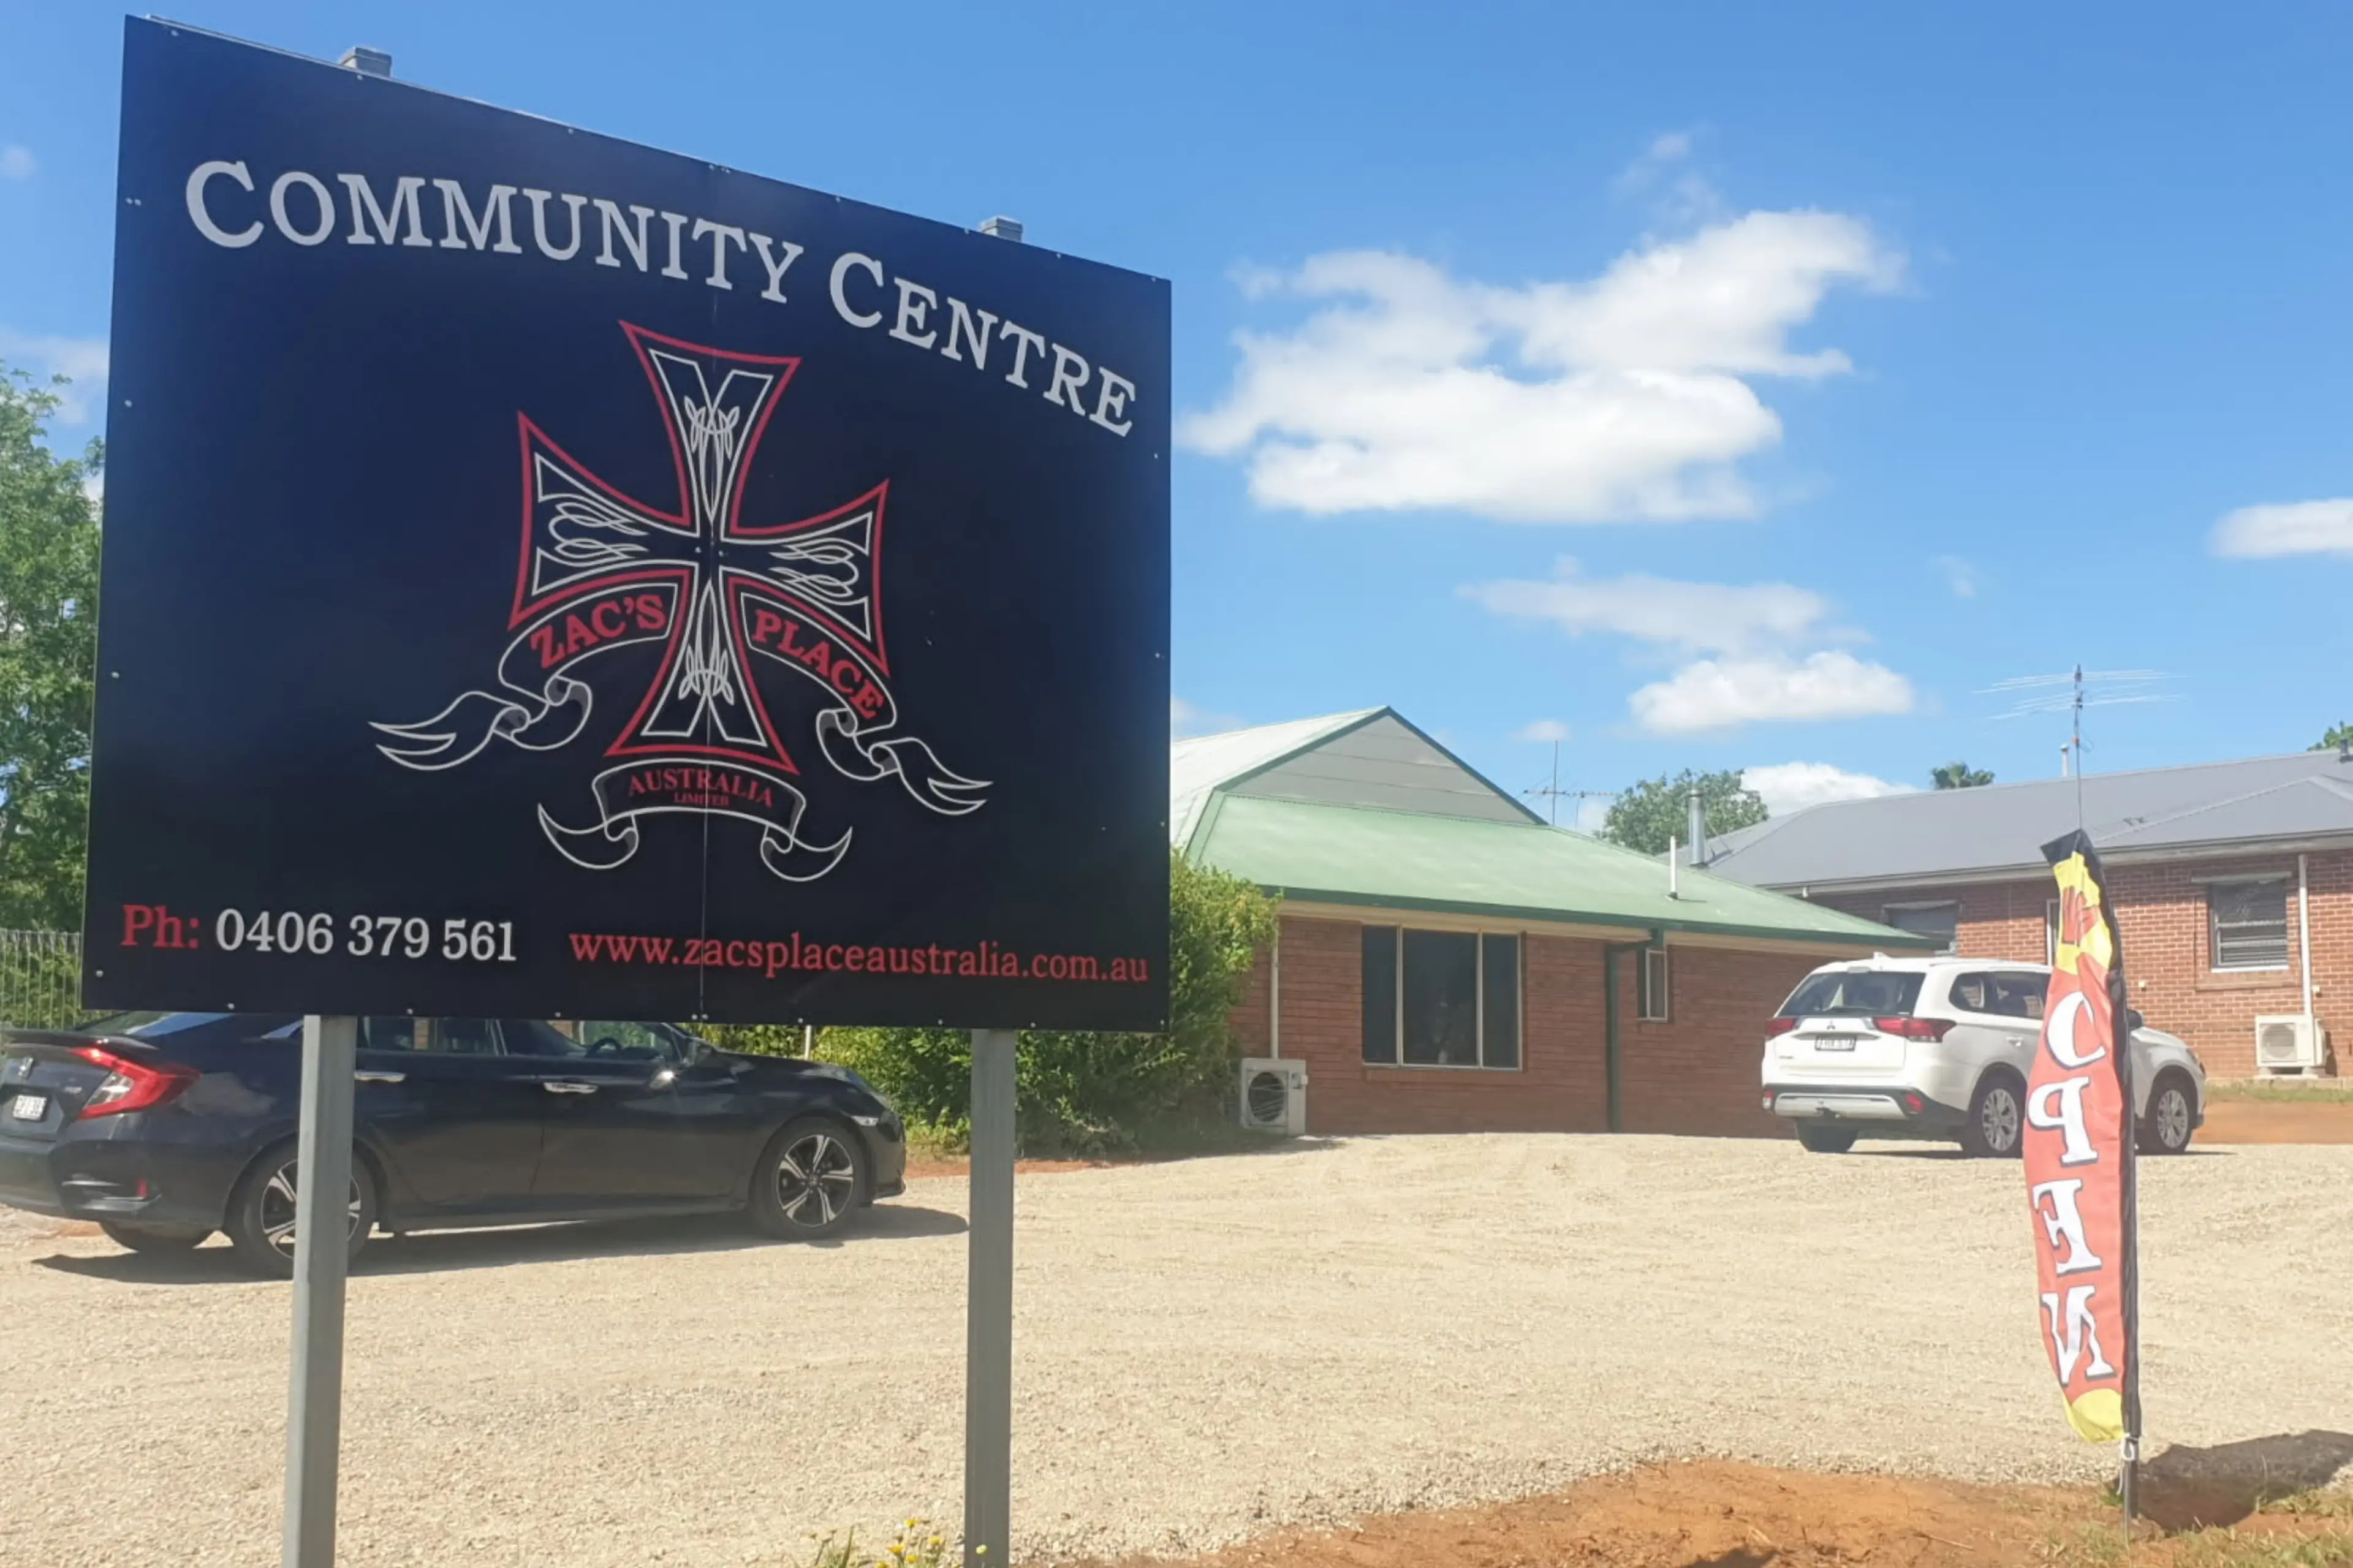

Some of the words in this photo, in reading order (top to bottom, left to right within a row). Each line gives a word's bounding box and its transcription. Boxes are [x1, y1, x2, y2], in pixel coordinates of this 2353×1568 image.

[186, 160, 804, 303] COMMUNITY
[830, 252, 1135, 437] CENTRE
[530, 594, 666, 669] ZAC'S
[751, 609, 884, 719] PLACE
[628, 768, 773, 808] AUSTRALIA
[674, 792, 730, 806] LIMITED
[120, 904, 200, 949] Ph:
[216, 909, 334, 954] 0406
[347, 915, 429, 958] 379
[442, 918, 516, 961] 561
[569, 932, 1149, 982] www.zacsplaceaustralia.com.au
